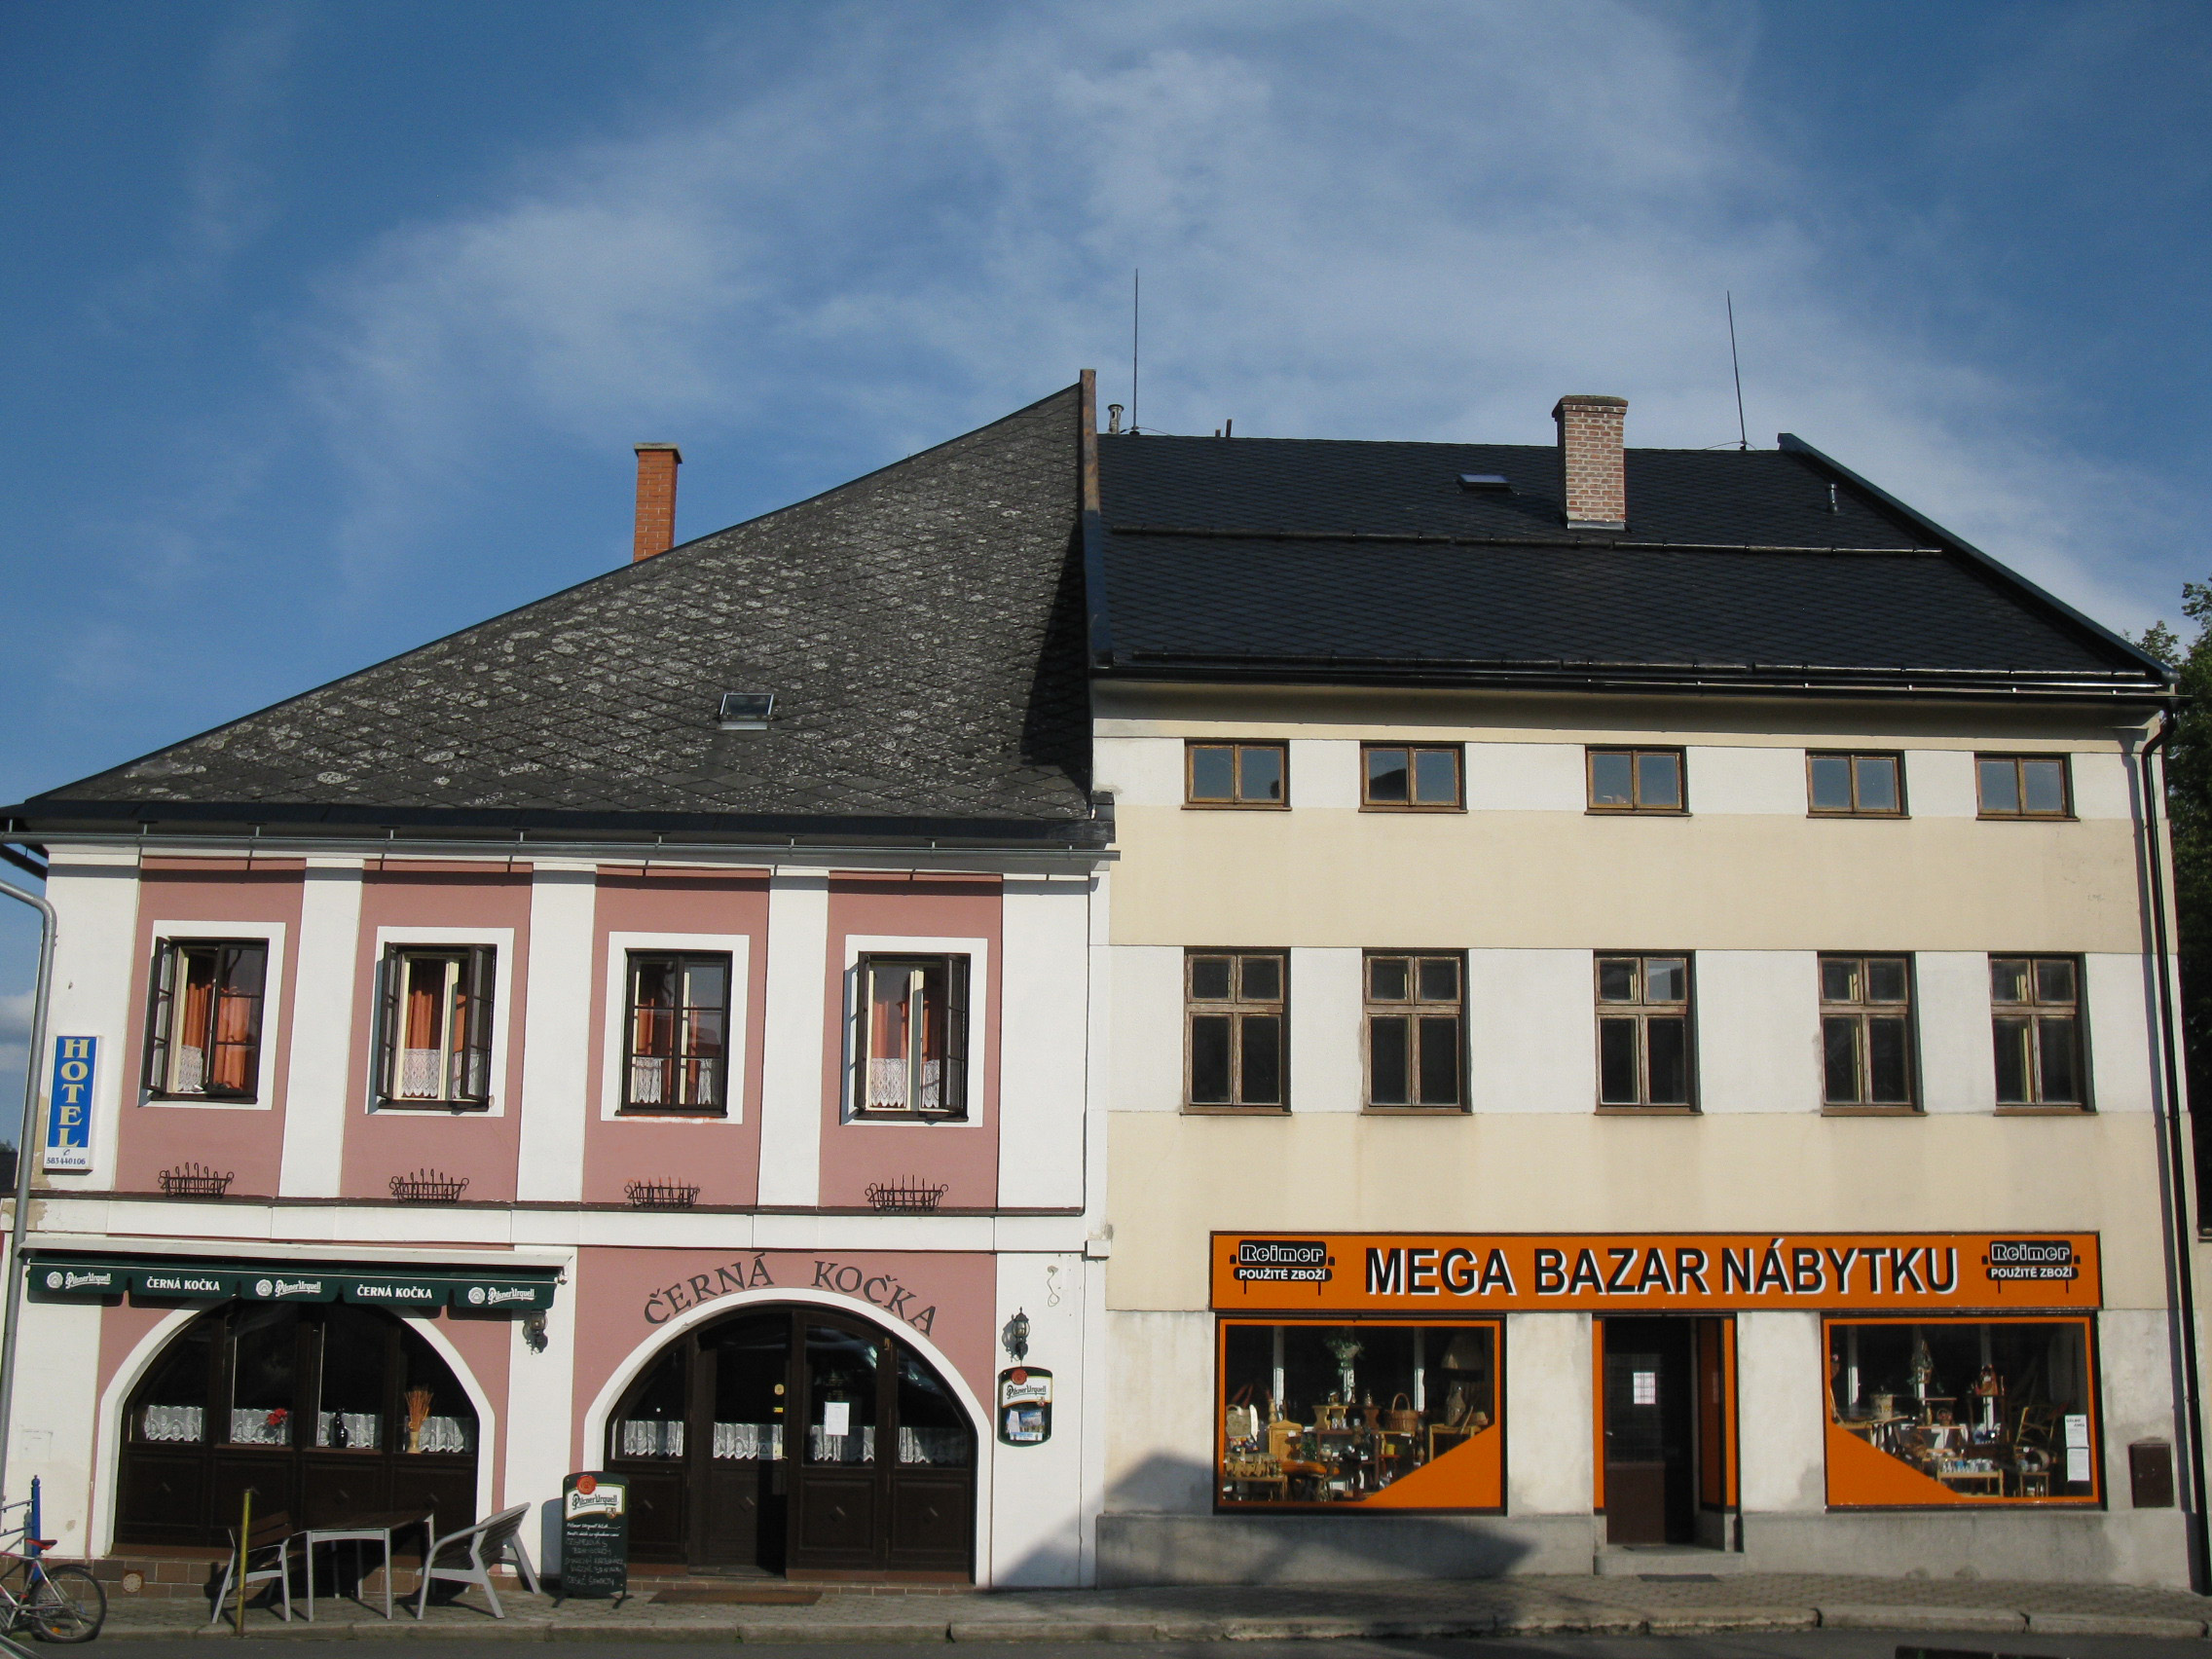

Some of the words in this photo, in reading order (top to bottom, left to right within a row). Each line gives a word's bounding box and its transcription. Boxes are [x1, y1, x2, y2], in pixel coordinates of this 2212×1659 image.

[57, 1038, 91, 1148] HOTEL
[1239, 1244, 1325, 1263] Reimer
[1991, 1243, 2071, 1262] Reimer
[1238, 1268, 1289, 1280] POUŽITÉ
[1290, 1268, 1327, 1280] ZBOŽÍ
[1365, 1247, 1517, 1296] MEGA
[1533, 1247, 1709, 1296] BAZAR
[1720, 1237, 1960, 1296] NÁBYTKU
[1990, 1266, 2039, 1278] POUŽITÉ
[2040, 1266, 2073, 1278] ZBOŽÍ
[65, 1271, 89, 1290] Pilsner
[88, 1272, 113, 1286] Urquell
[146, 1275, 181, 1290] ČERNÁ
[184, 1277, 221, 1292] KOČKA
[275, 1278, 299, 1298] Pilsner
[298, 1279, 322, 1294] Urquell
[356, 1283, 392, 1298] ČERNÁ
[395, 1285, 433, 1299] KOČKA
[487, 1286, 512, 1306] Pilsner
[511, 1287, 535, 1302] Urquell
[644, 1252, 775, 1325] ČERNÁ
[810, 1260, 938, 1337] KOČKA
[1006, 1384, 1027, 1400] Pilsner
[1026, 1384, 1047, 1396] Urquell
[571, 1493, 595, 1511] Pilsner
[595, 1493, 618, 1507] Urquell
